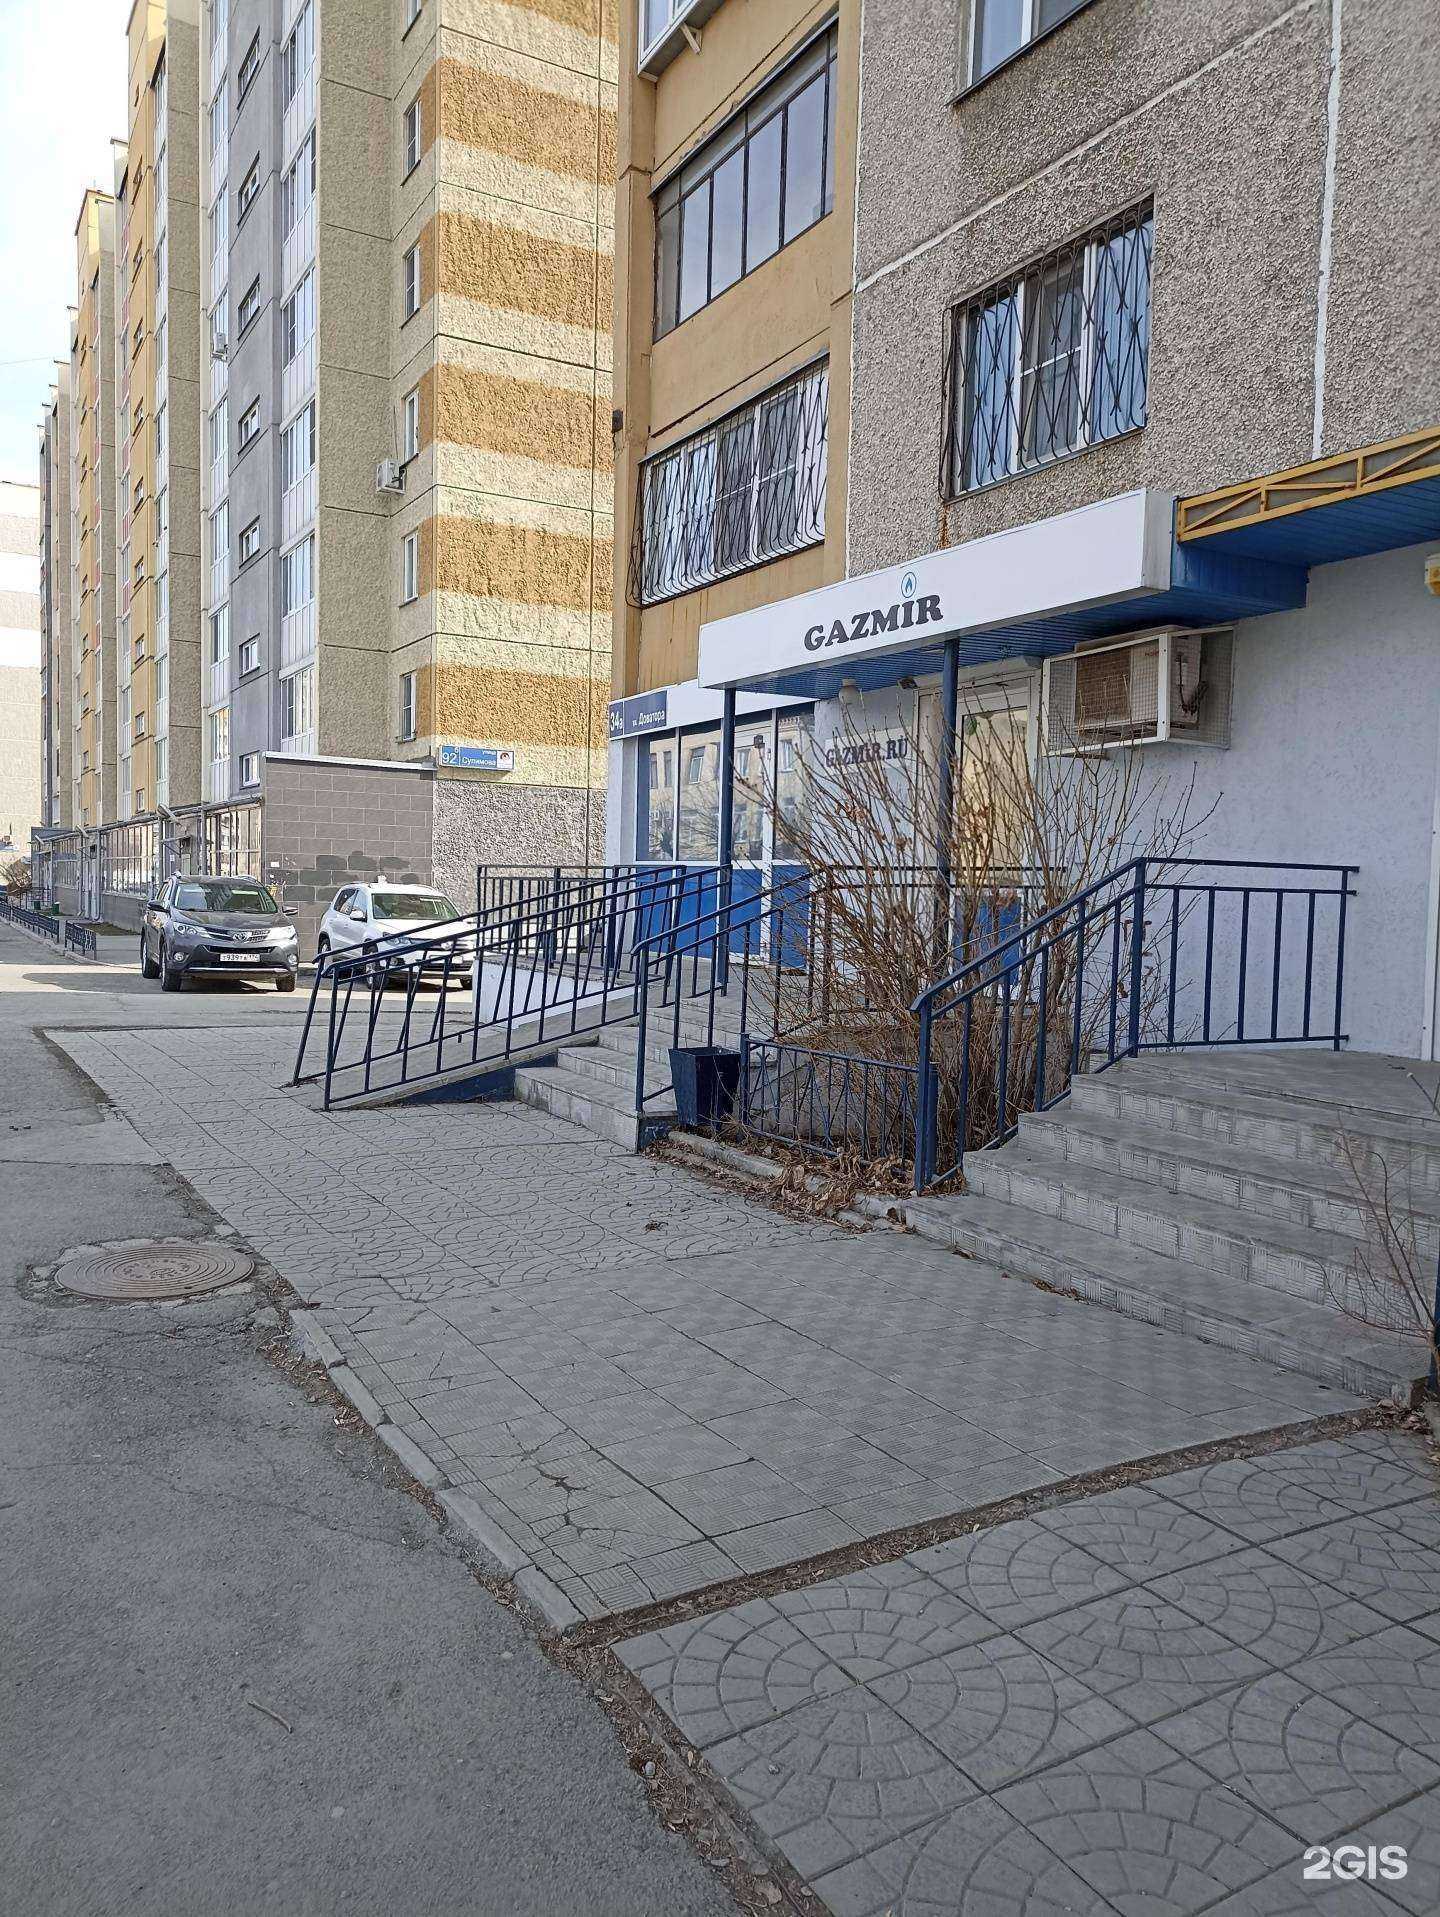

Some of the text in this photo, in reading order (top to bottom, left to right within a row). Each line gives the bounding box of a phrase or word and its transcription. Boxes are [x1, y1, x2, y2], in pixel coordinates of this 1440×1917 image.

[804, 595, 943, 650] GAZMIR
[638, 710, 665, 726] Доватора
[442, 752, 457, 764] 92
